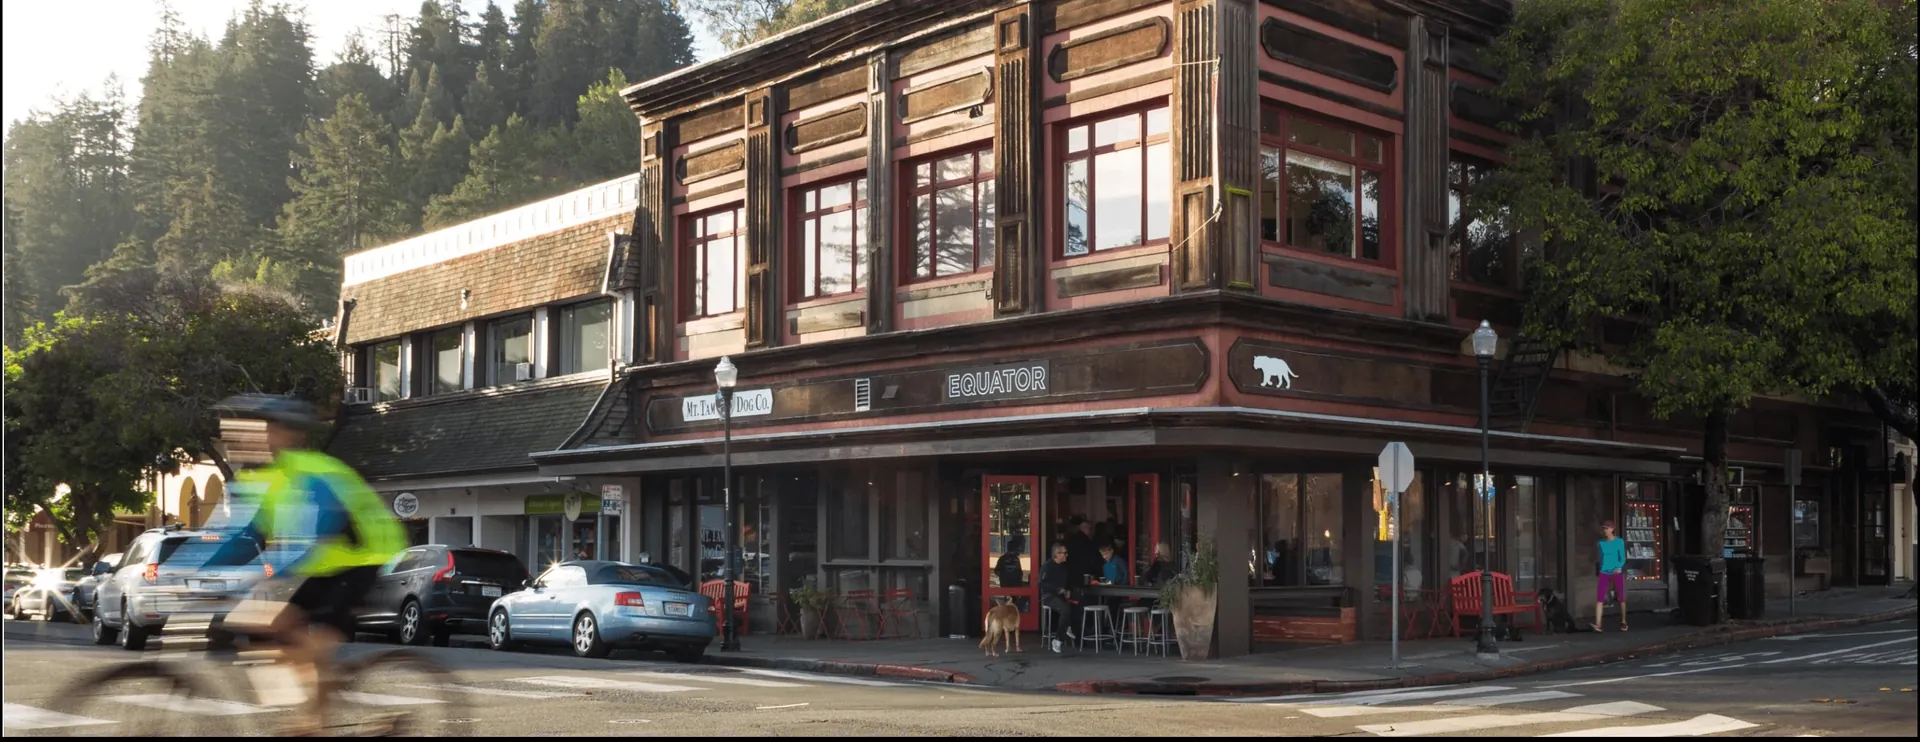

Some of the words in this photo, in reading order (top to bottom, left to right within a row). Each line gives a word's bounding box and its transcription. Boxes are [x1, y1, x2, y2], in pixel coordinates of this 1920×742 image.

[948, 366, 1046, 398] EQUATOR
[686, 401, 700, 417] MT.
[700, 400, 716, 416] TAM
[736, 396, 754, 413] DOG
[755, 393, 770, 411] CO.
